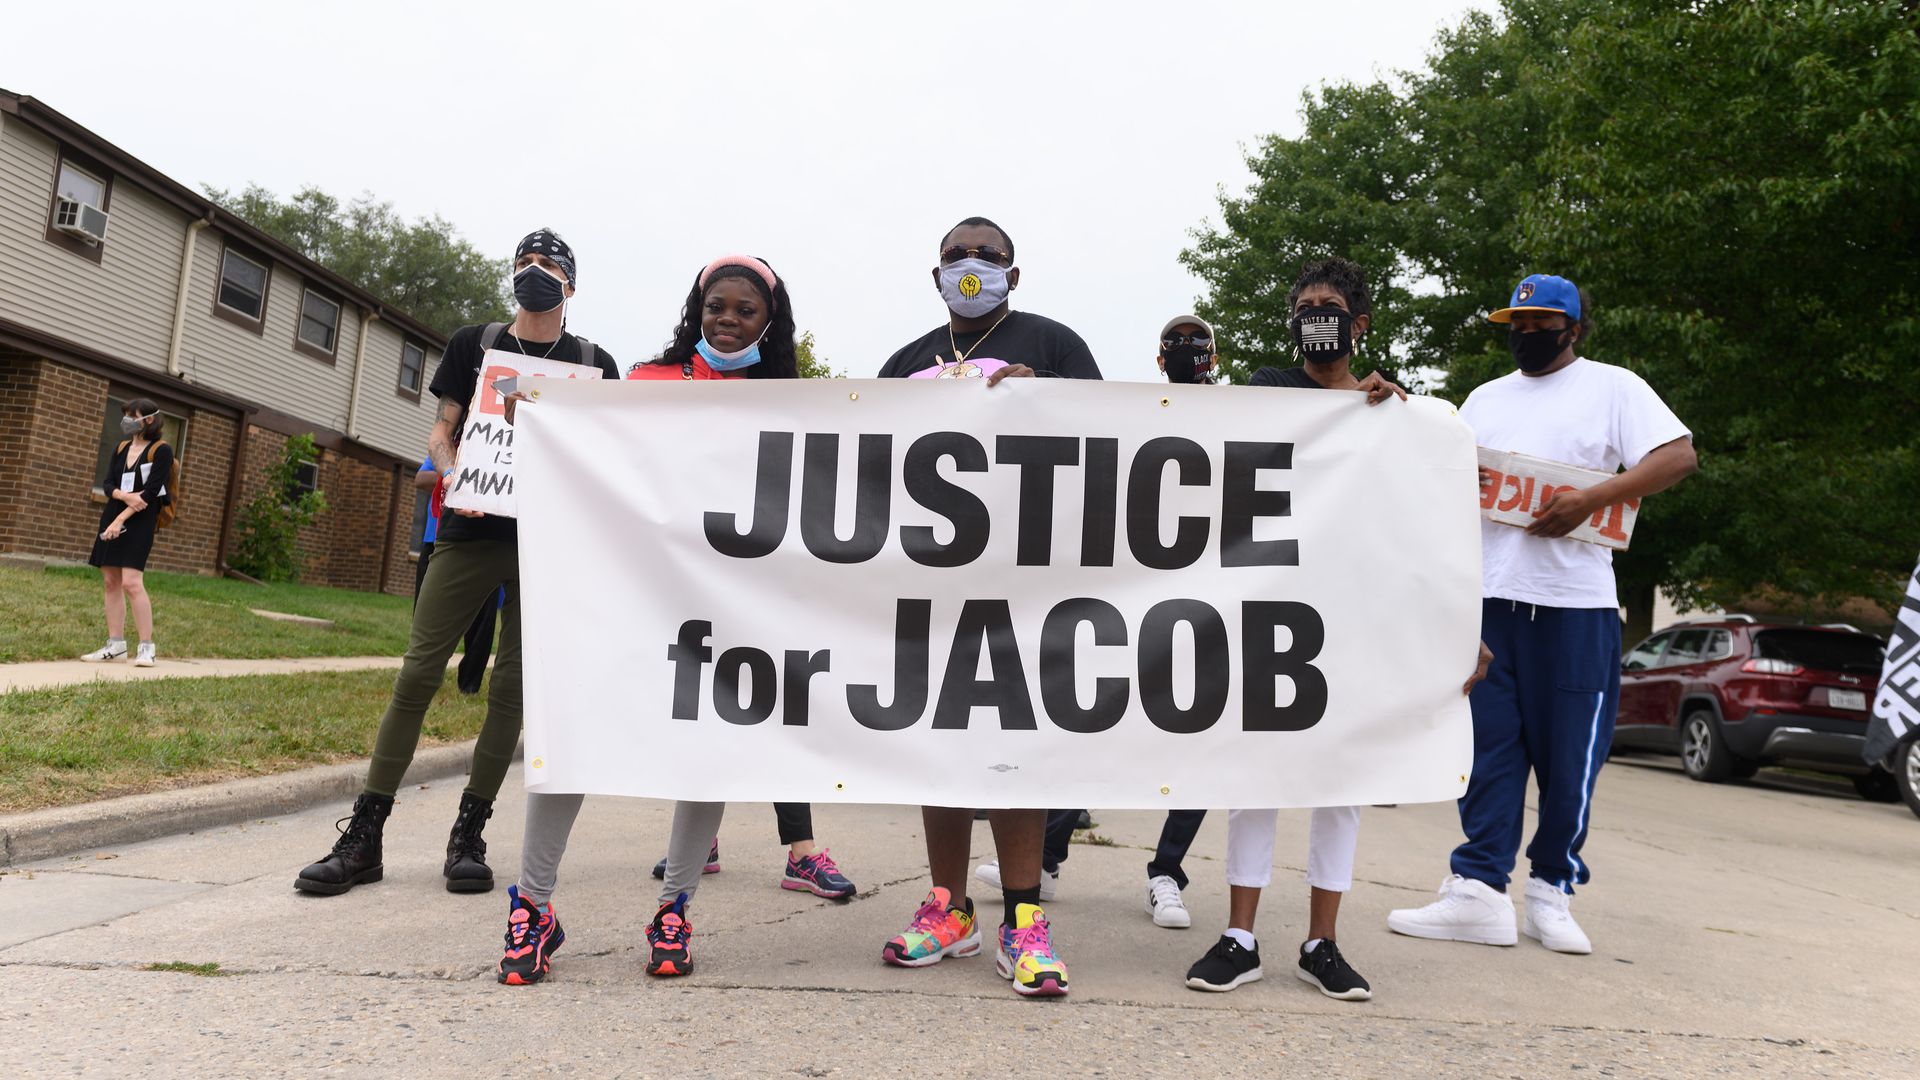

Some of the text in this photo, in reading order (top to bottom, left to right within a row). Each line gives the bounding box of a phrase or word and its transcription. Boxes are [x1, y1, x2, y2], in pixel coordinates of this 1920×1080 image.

[1302, 342, 1339, 352] STAND
[704, 432, 1300, 568] JUSTICE
[668, 598, 1328, 734] for JACOB
